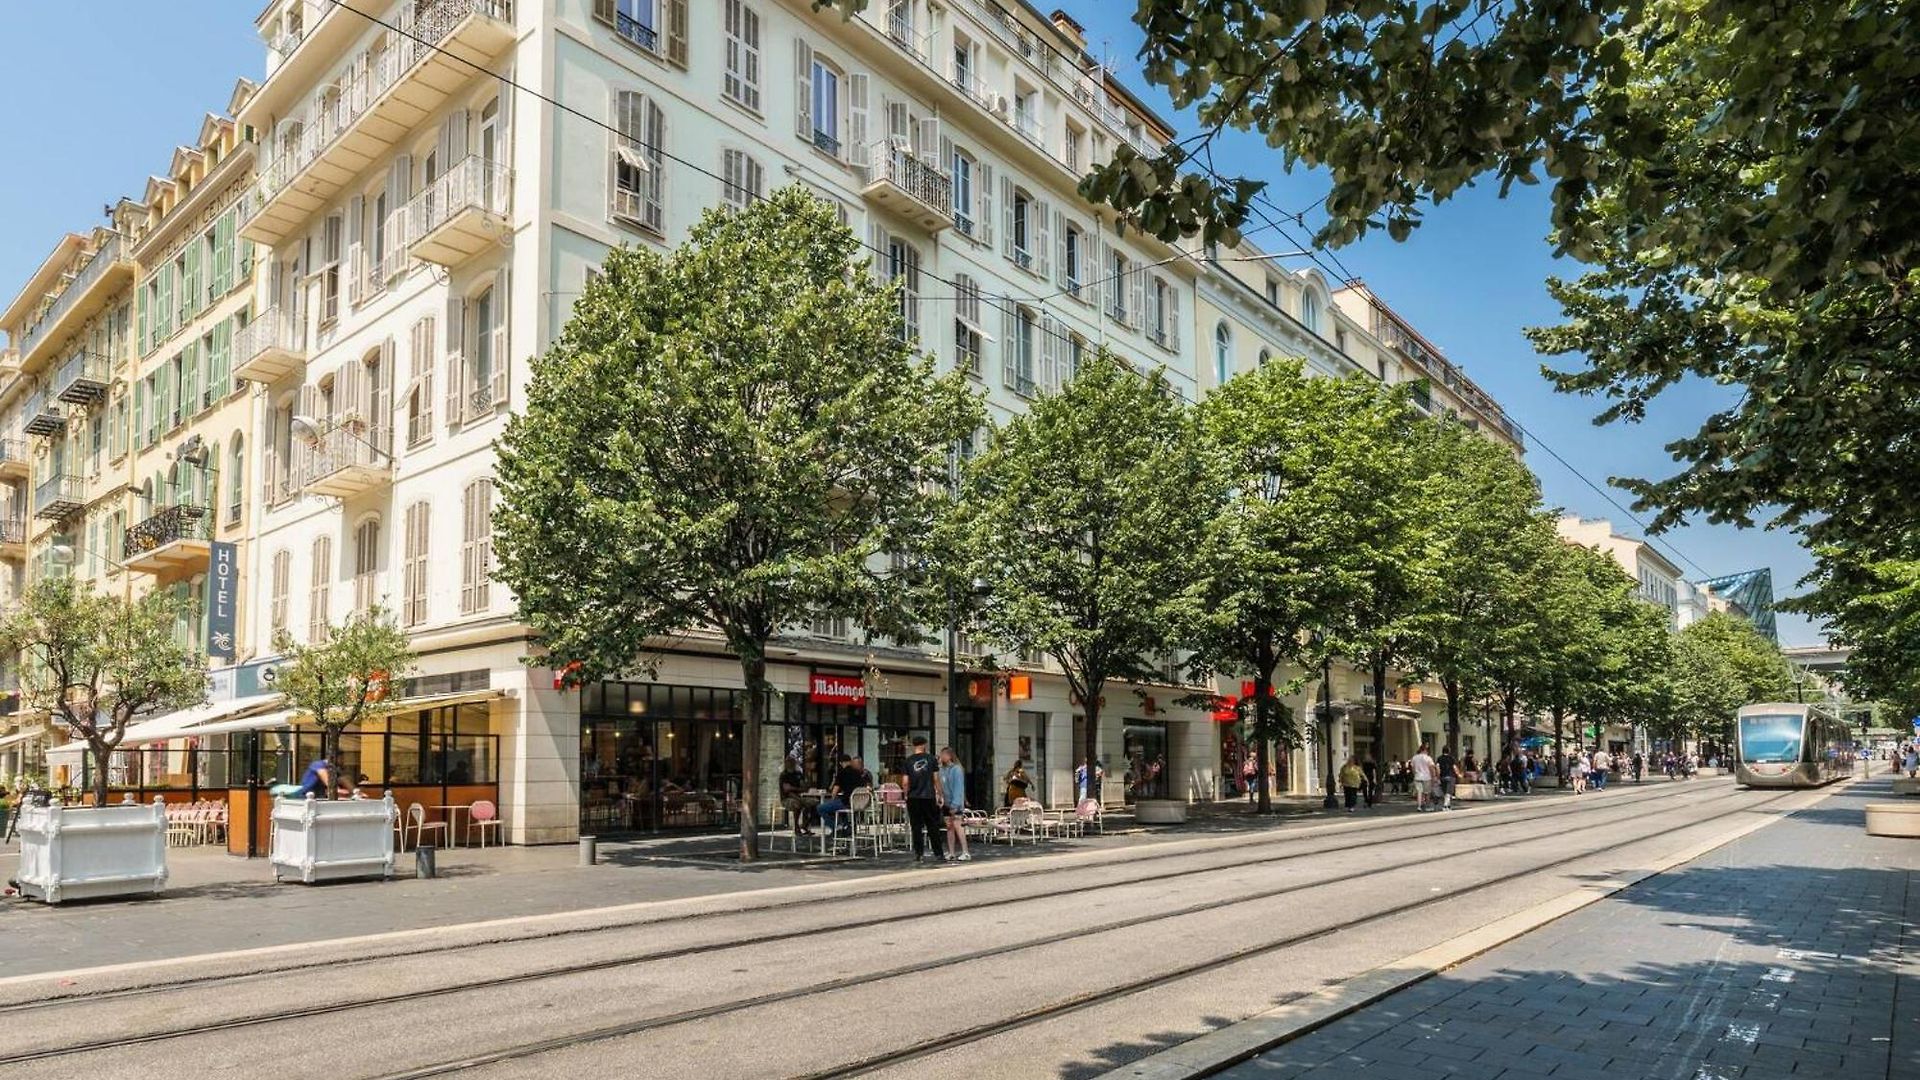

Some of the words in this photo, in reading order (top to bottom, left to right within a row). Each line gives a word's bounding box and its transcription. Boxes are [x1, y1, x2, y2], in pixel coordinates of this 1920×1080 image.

[184, 214, 198, 241] DU
[202, 170, 248, 223] CENTRE
[218, 549, 229, 617] HOTEL
[814, 679, 864, 701] Malongo
